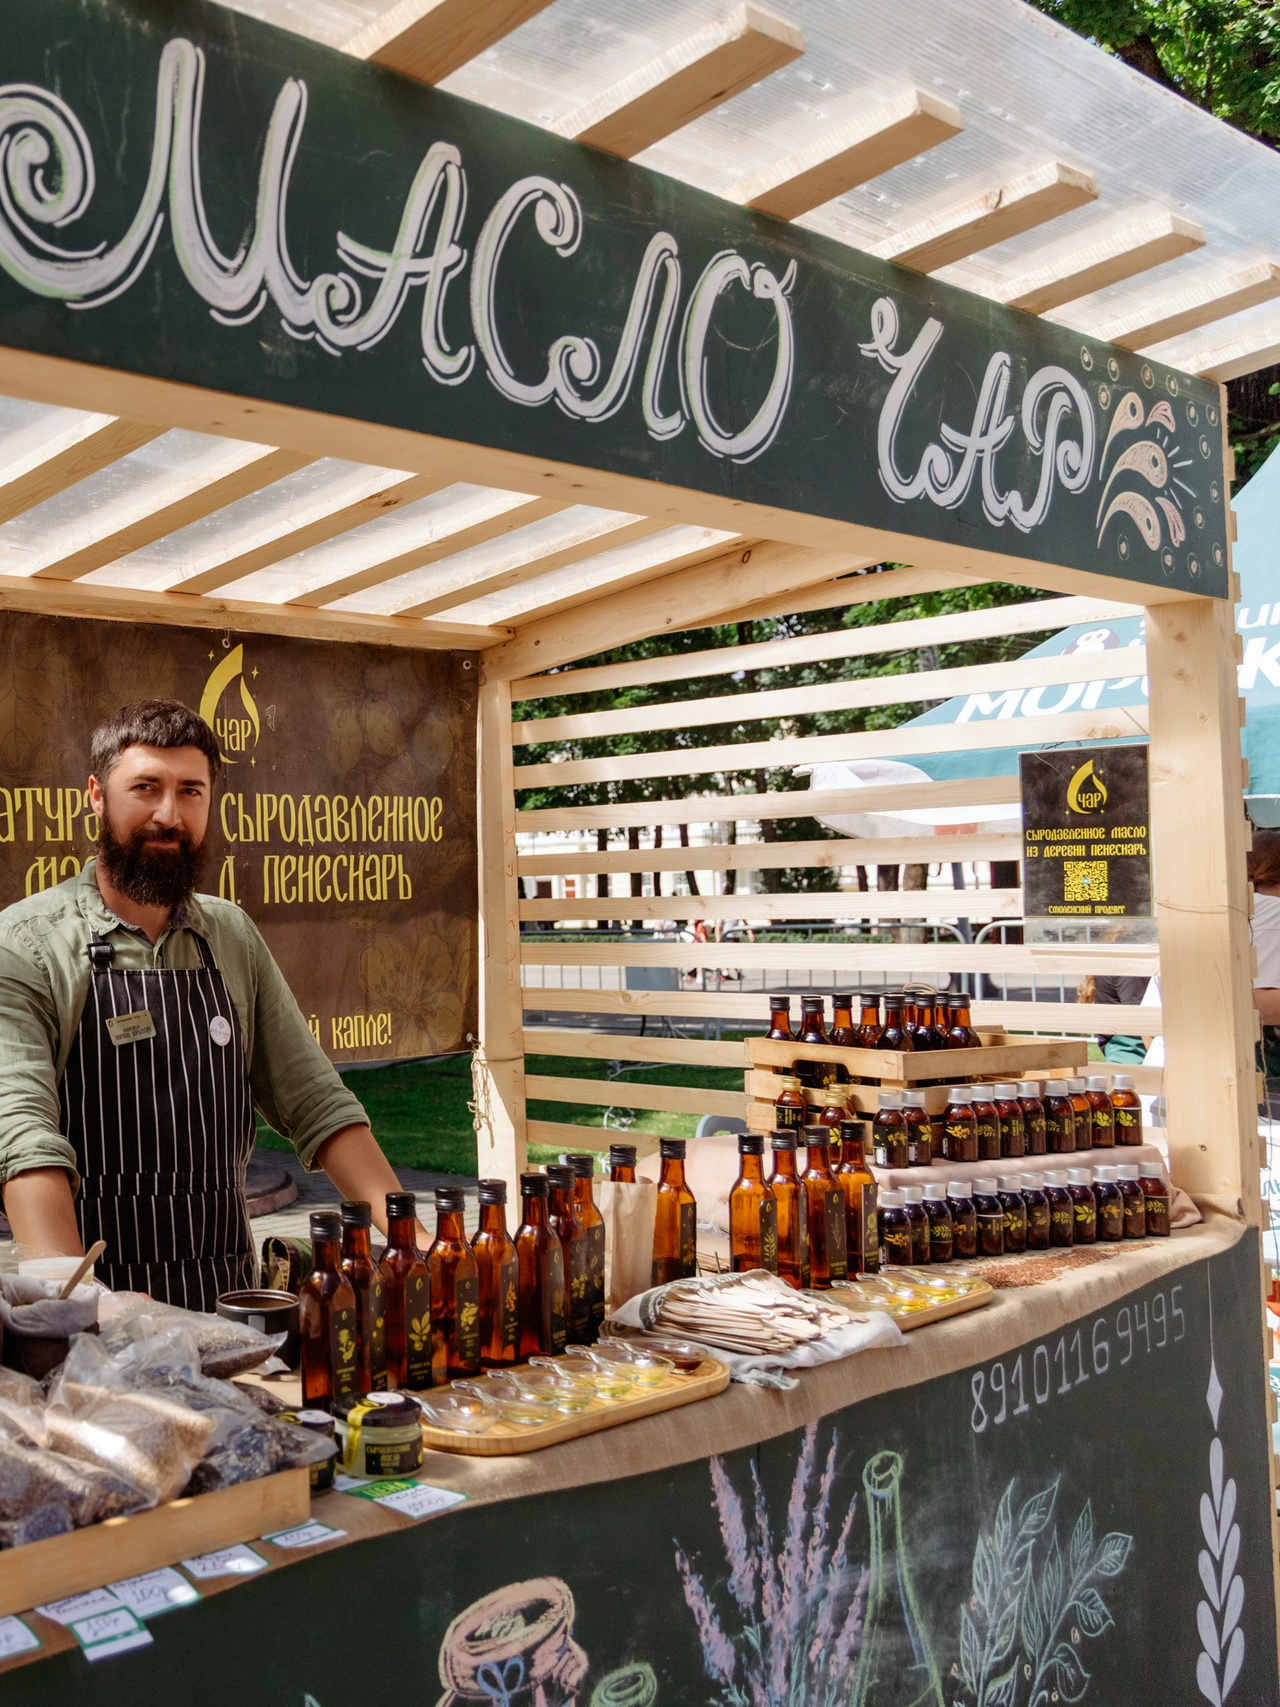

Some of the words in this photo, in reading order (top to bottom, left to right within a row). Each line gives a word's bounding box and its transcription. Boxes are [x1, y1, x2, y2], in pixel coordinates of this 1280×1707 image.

[858, 295, 1096, 534] ЧАР
[220, 792, 443, 847] СЫРОДАВЛЕННОЕ
[1111, 826, 1146, 839] МАСЛО
